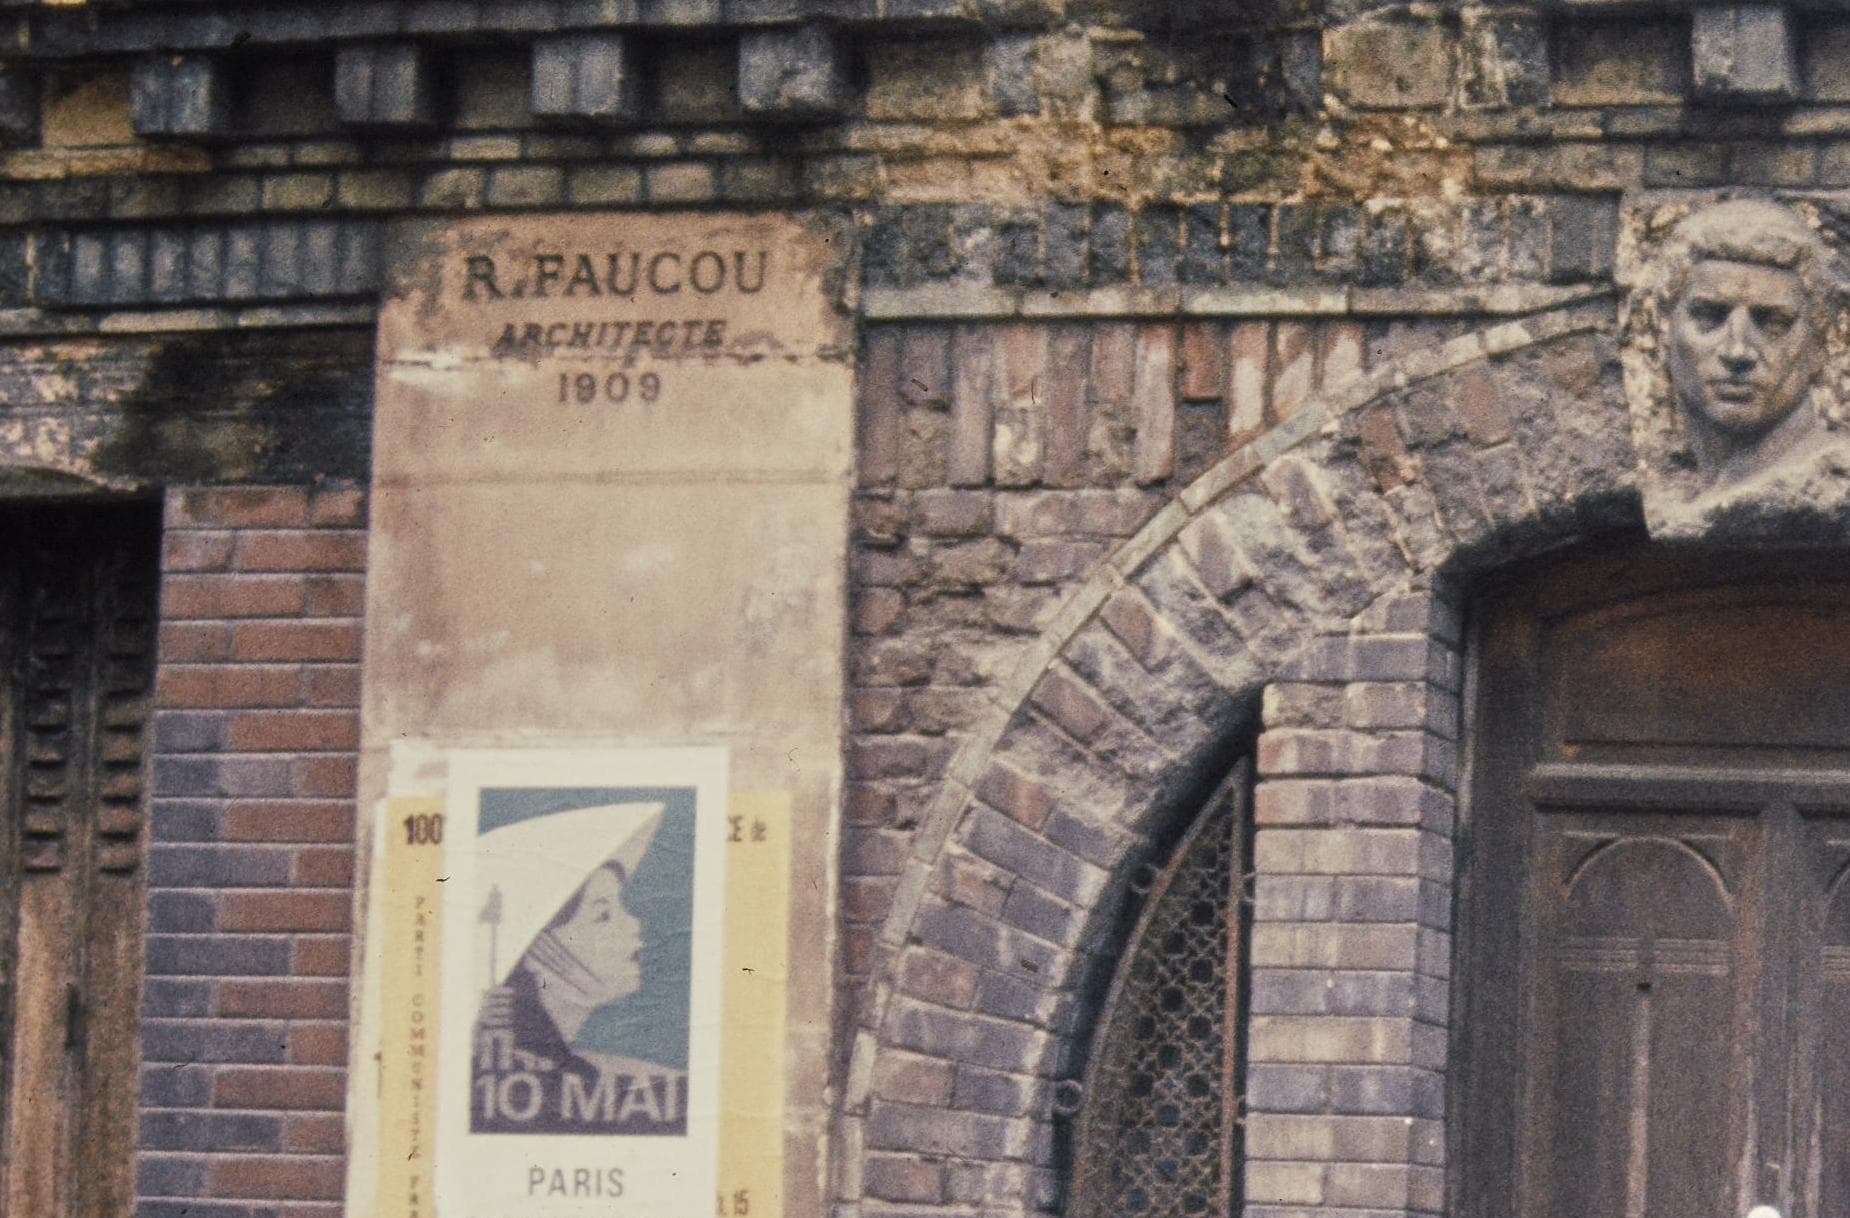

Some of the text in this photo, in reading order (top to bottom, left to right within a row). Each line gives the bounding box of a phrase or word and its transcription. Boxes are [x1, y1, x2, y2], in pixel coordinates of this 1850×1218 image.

[534, 250, 769, 298] FAUCOU
[496, 319, 728, 353] ARCHITECTE
[558, 371, 661, 403] 1909
[475, 1071, 678, 1123] 10 MAI
[527, 1166, 626, 1199] PARIS
